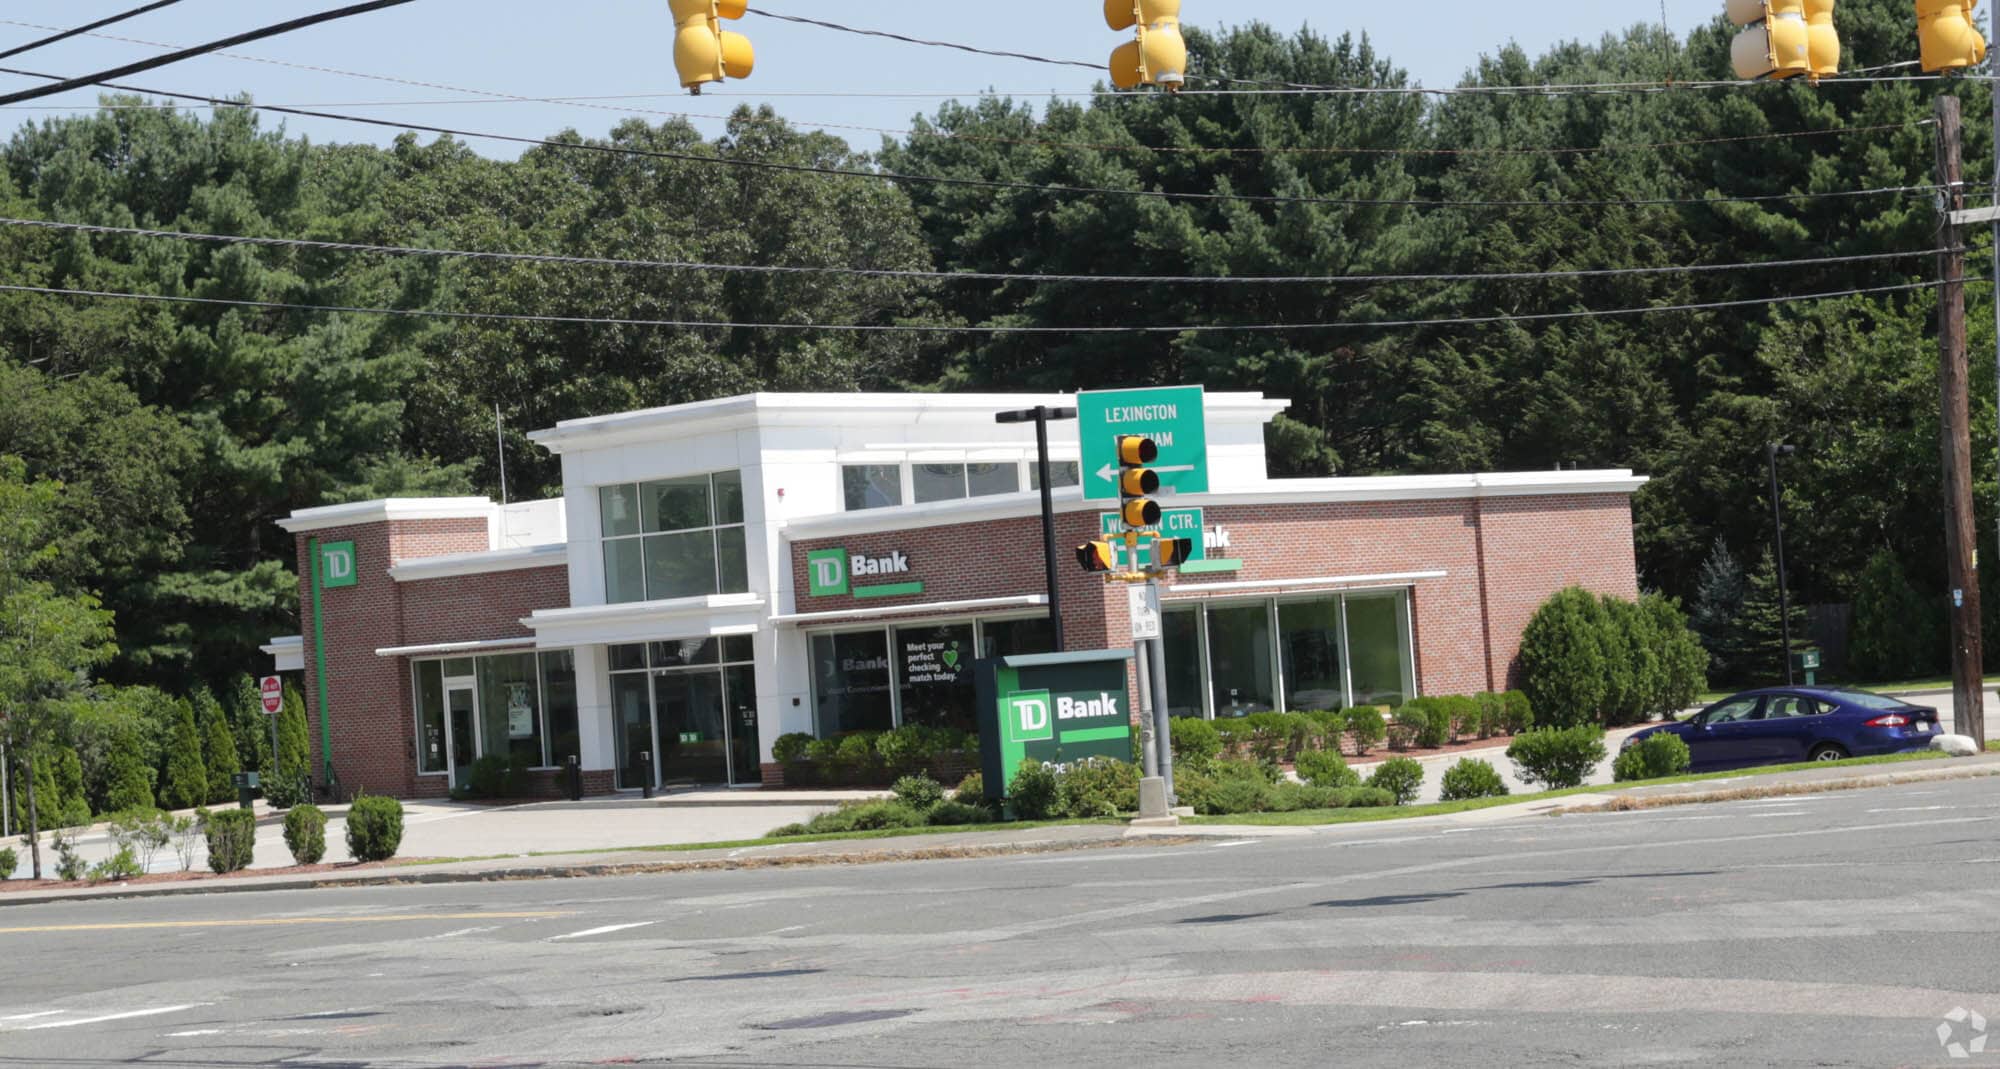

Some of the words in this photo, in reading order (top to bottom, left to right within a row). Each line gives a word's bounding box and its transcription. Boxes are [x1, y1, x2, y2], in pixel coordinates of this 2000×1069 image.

[1105, 404, 1177, 423] LEXINGTON
[1169, 513, 1198, 530] CTR.
[1204, 525, 1231, 548] nk
[324, 551, 351, 578] TD
[811, 557, 842, 587] TD
[851, 551, 908, 576] Bank
[907, 643, 926, 651] Meet
[927, 642, 944, 652] your
[908, 652, 935, 664] perfect
[908, 662, 941, 672] checking
[1013, 699, 1048, 730] TD
[1057, 692, 1117, 719] Bank
